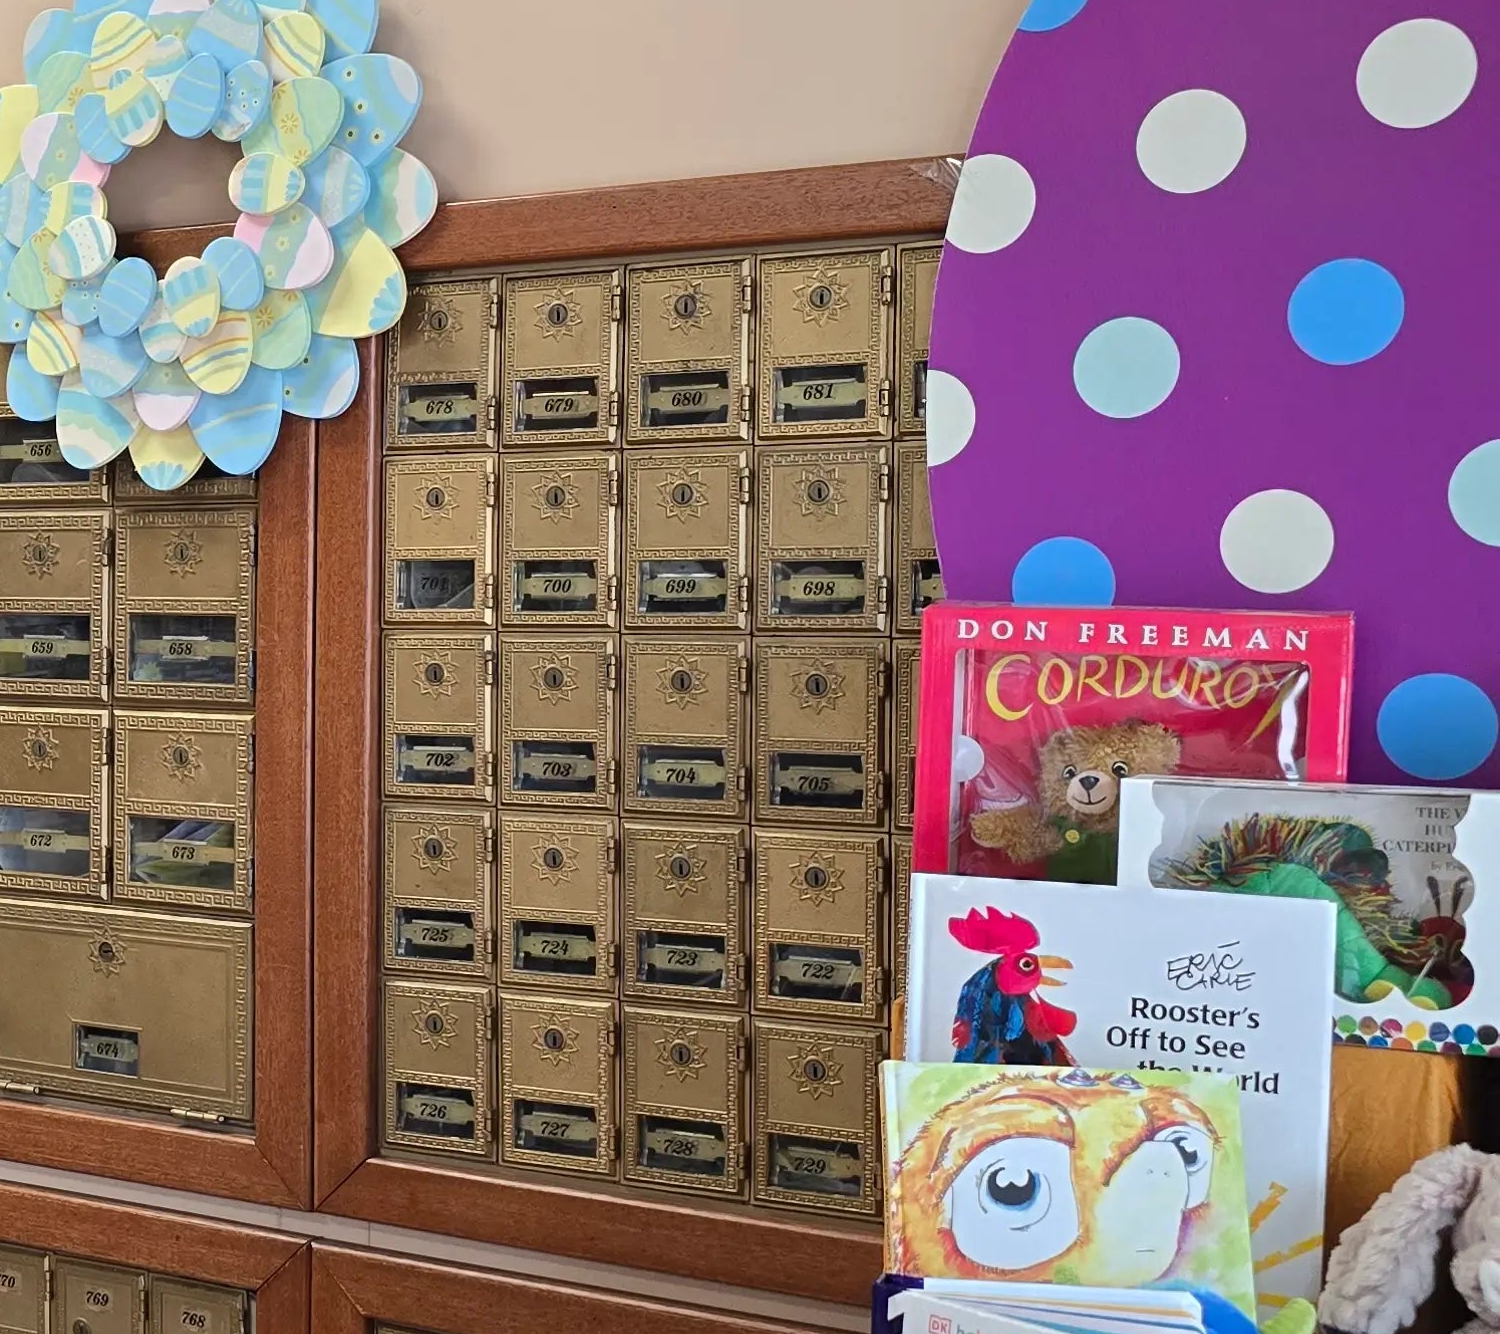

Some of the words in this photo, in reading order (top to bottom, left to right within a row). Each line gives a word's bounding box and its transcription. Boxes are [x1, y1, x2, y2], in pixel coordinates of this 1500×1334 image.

[671, 391, 702, 407] 680
[803, 383, 834, 400] 681
[425, 399, 454, 415] 678
[544, 397, 574, 413] 679
[30, 444, 52, 457] 656
[542, 578, 572, 593] 700
[665, 578, 696, 594] 699
[803, 580, 835, 597] 698
[957, 619, 1048, 642] DON
[1078, 622, 1309, 651] FREEMAN
[31, 641, 53, 656] 659
[168, 642, 192, 656] 658
[425, 752, 454, 768] 702
[542, 761, 572, 777] 703
[665, 767, 696, 784] 704
[798, 775, 830, 792] 705
[1416, 807, 1451, 820] THE
[30, 834, 52, 848] 672
[171, 845, 196, 860] 673
[421, 927, 449, 943] 725
[540, 938, 569, 956] 724
[666, 949, 698, 967] 723
[1167, 941, 1243, 980] ERIC
[801, 962, 834, 980] 722
[1176, 971, 1256, 991] CARLE
[1131, 997, 1260, 1029] Rooster's
[96, 1041, 119, 1057] 674
[1106, 1025, 1152, 1050] Off
[1158, 1031, 1186, 1053] to
[1195, 1034, 1246, 1059] See
[419, 1103, 447, 1119] 726
[540, 1120, 569, 1137] 727
[663, 1137, 694, 1155] 728
[793, 1155, 826, 1175] 729
[86, 1291, 109, 1307] 769
[181, 1311, 206, 1329] 768
[931, 1318, 950, 1334] DK
